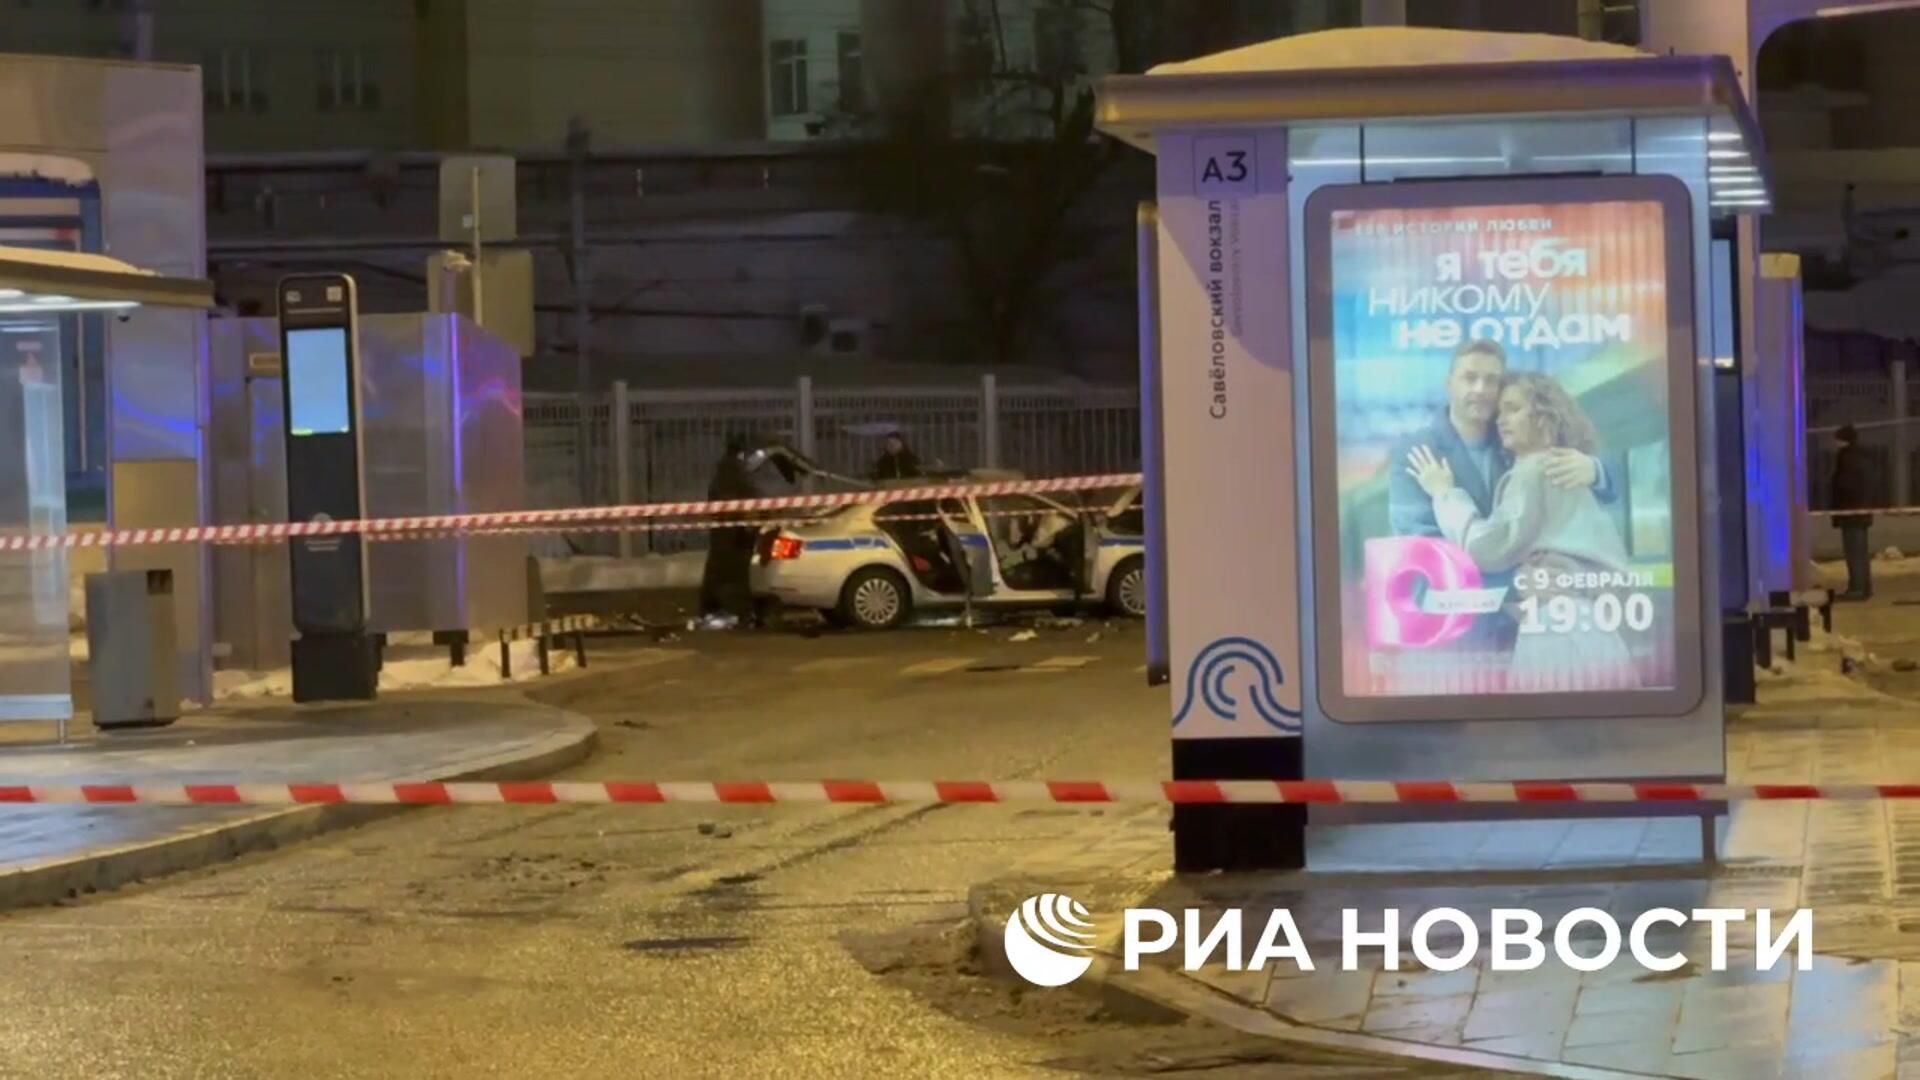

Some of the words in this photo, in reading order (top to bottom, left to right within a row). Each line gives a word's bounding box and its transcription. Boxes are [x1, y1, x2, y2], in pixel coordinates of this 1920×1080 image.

[1209, 200, 1222, 273] вокзал
[1393, 219, 1478, 235] ИСТОРИИ
[1486, 218, 1553, 233] ЛЮБВИ
[1206, 280, 1226, 419] Савёловский
[1535, 569, 1549, 590] 9
[1556, 571, 1654, 588] ФЕВРАЛЯ
[1518, 593, 1654, 634] 19:00
